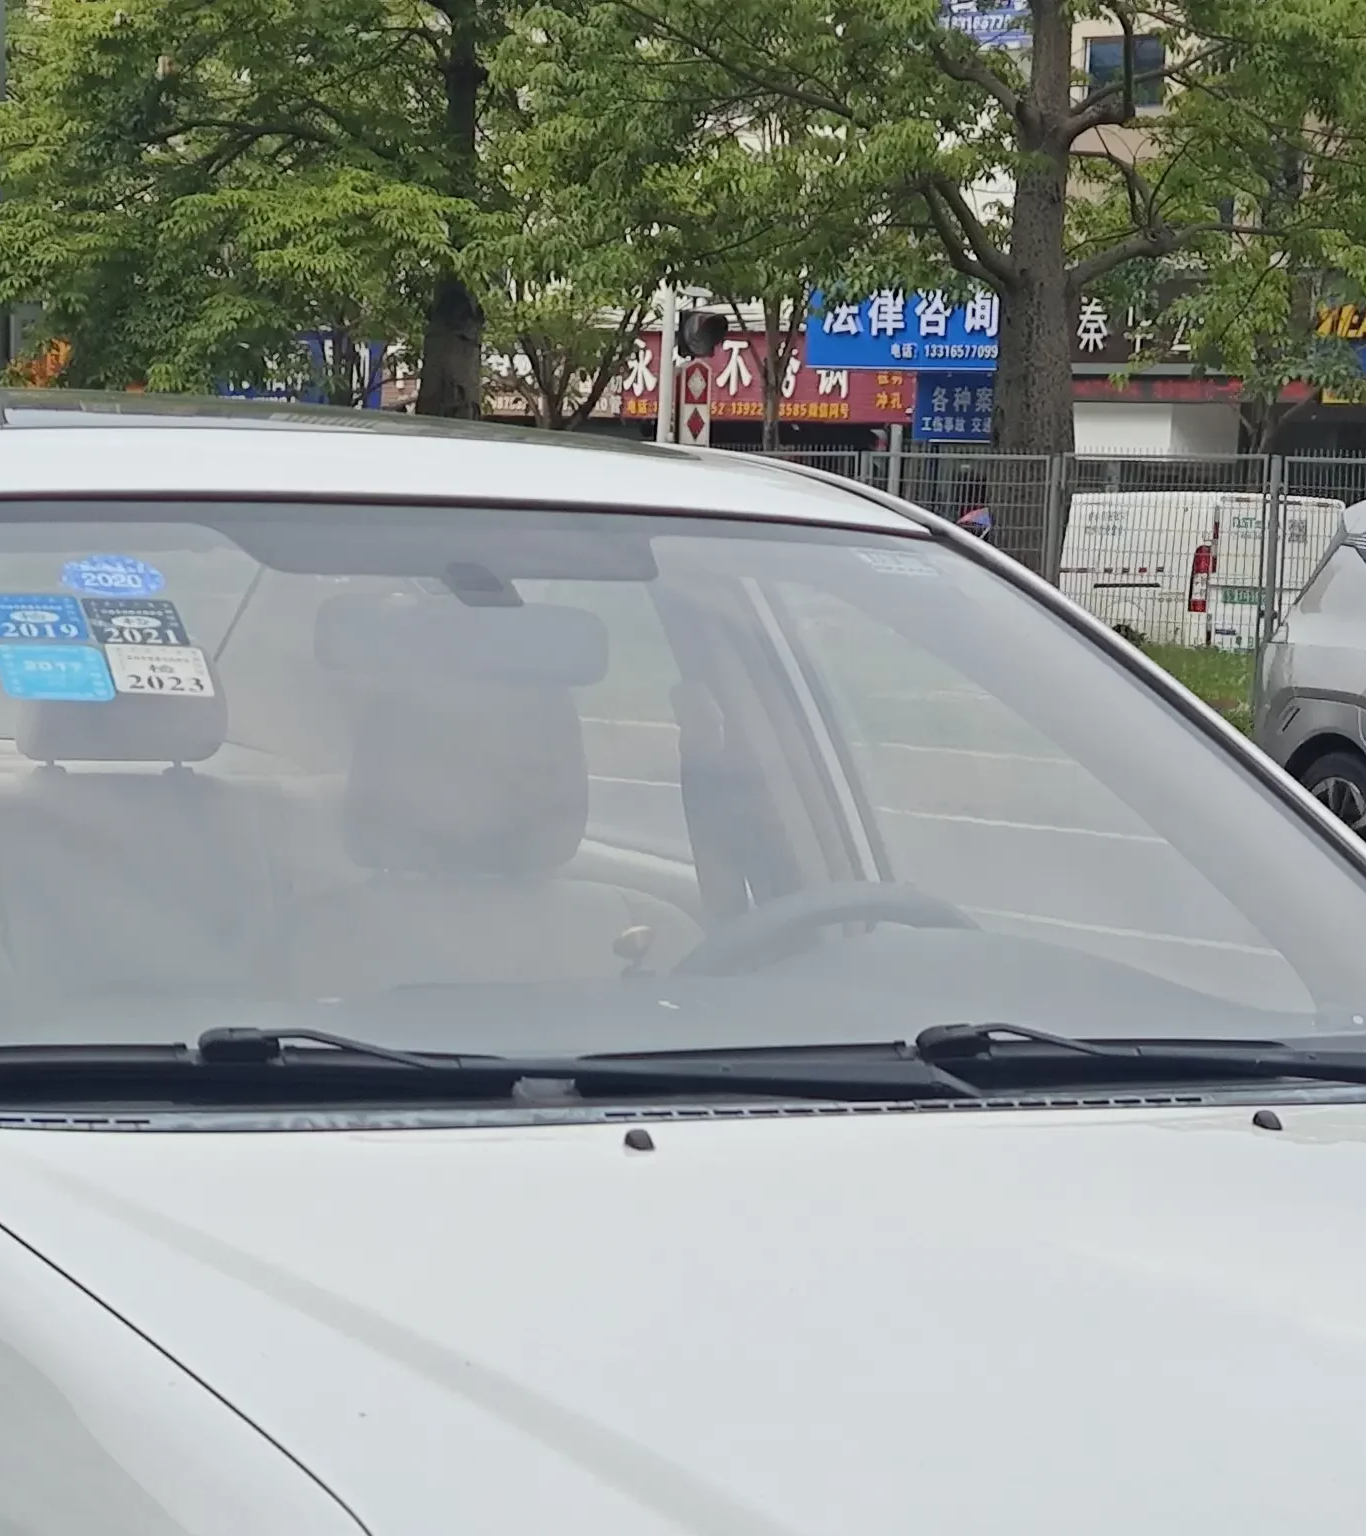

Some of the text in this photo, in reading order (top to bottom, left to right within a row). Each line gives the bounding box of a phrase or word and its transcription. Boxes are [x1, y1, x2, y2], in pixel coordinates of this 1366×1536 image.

[924, 344, 999, 359] 13316577099
[932, 385, 994, 412] 各种案
[81, 572, 143, 589] 2020
[0, 622, 79, 638] 2019
[104, 627, 180, 644] 2021
[127, 674, 204, 693] 2023
